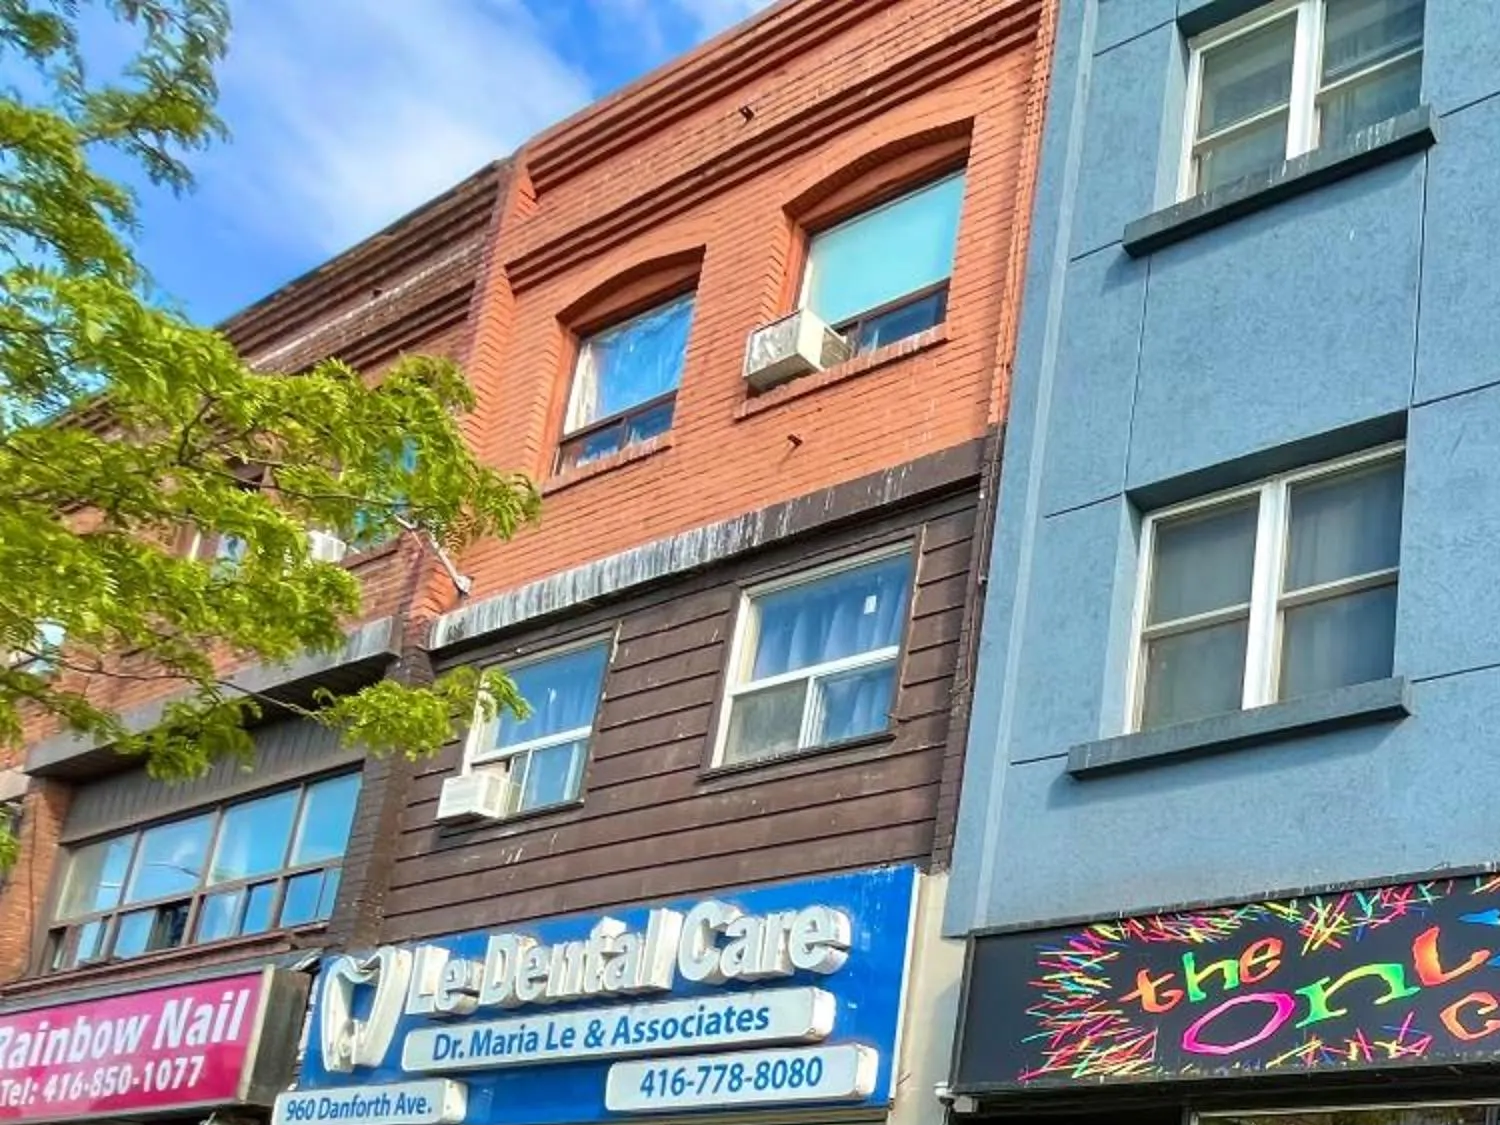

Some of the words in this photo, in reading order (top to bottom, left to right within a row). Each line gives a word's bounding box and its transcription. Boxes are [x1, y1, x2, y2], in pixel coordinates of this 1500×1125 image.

[405, 945, 482, 1016] Le
[478, 907, 684, 1007] Dental
[678, 900, 852, 983] Care
[1121, 937, 1283, 1015] the
[152, 989, 250, 1050] Nail
[433, 1033, 466, 1062] Dr.
[468, 1024, 539, 1058] Maria
[546, 1019, 576, 1050] Le
[583, 1020, 602, 1048] &
[616, 1004, 769, 1047] Associates
[43, 1055, 204, 1105] 416-850-1077
[639, 1056, 823, 1099] 416-778-8080
[286, 1100, 317, 1122] 960
[319, 1096, 390, 1120] Danforth
[392, 1098, 433, 1118] Ave.
